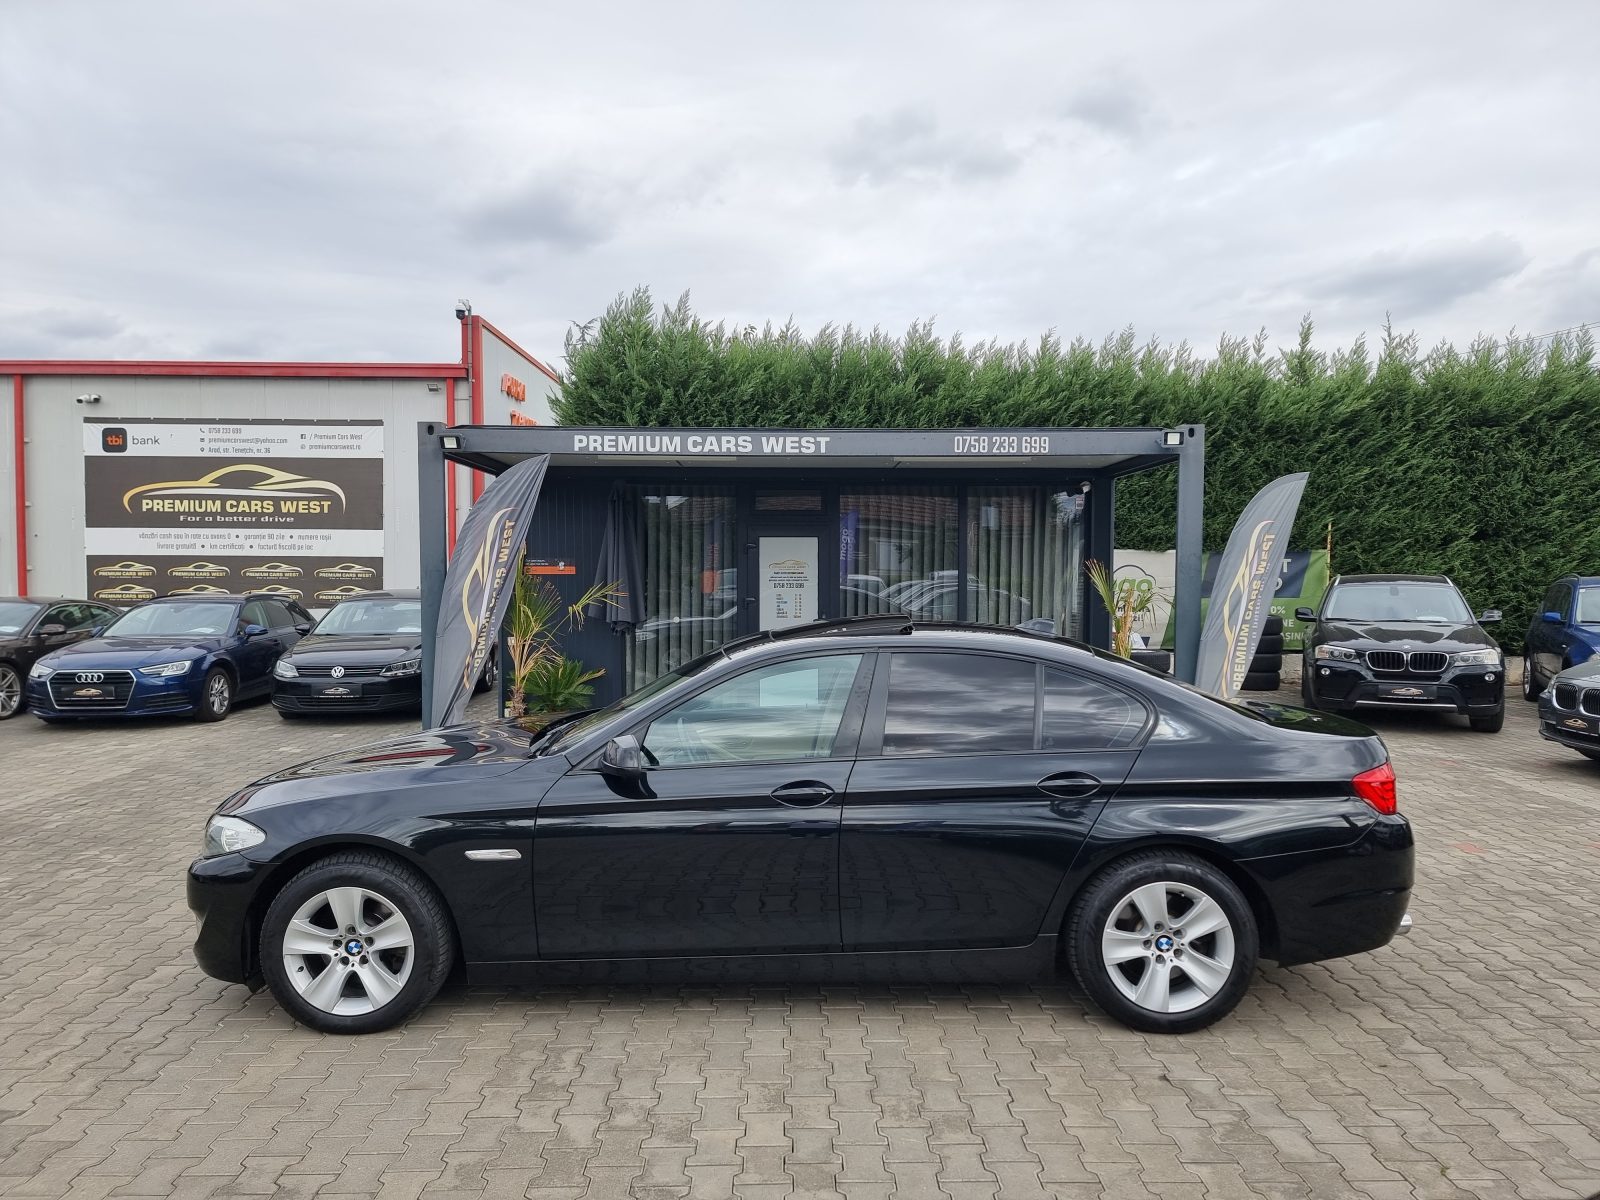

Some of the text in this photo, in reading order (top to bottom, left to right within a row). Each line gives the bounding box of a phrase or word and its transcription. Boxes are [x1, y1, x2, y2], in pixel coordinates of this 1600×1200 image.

[106, 435, 160, 446] tbi bank
[573, 434, 830, 454] PREMIUM CARS WEST
[954, 436, 1049, 453] 0758 233 699
[141, 499, 331, 513] PREMIUM CARS WEST
[498, 519, 516, 565] WEST
[1233, 623, 1250, 690] PREMIUM
[1245, 580, 1262, 620] CARS
[1256, 533, 1276, 574] WEST
